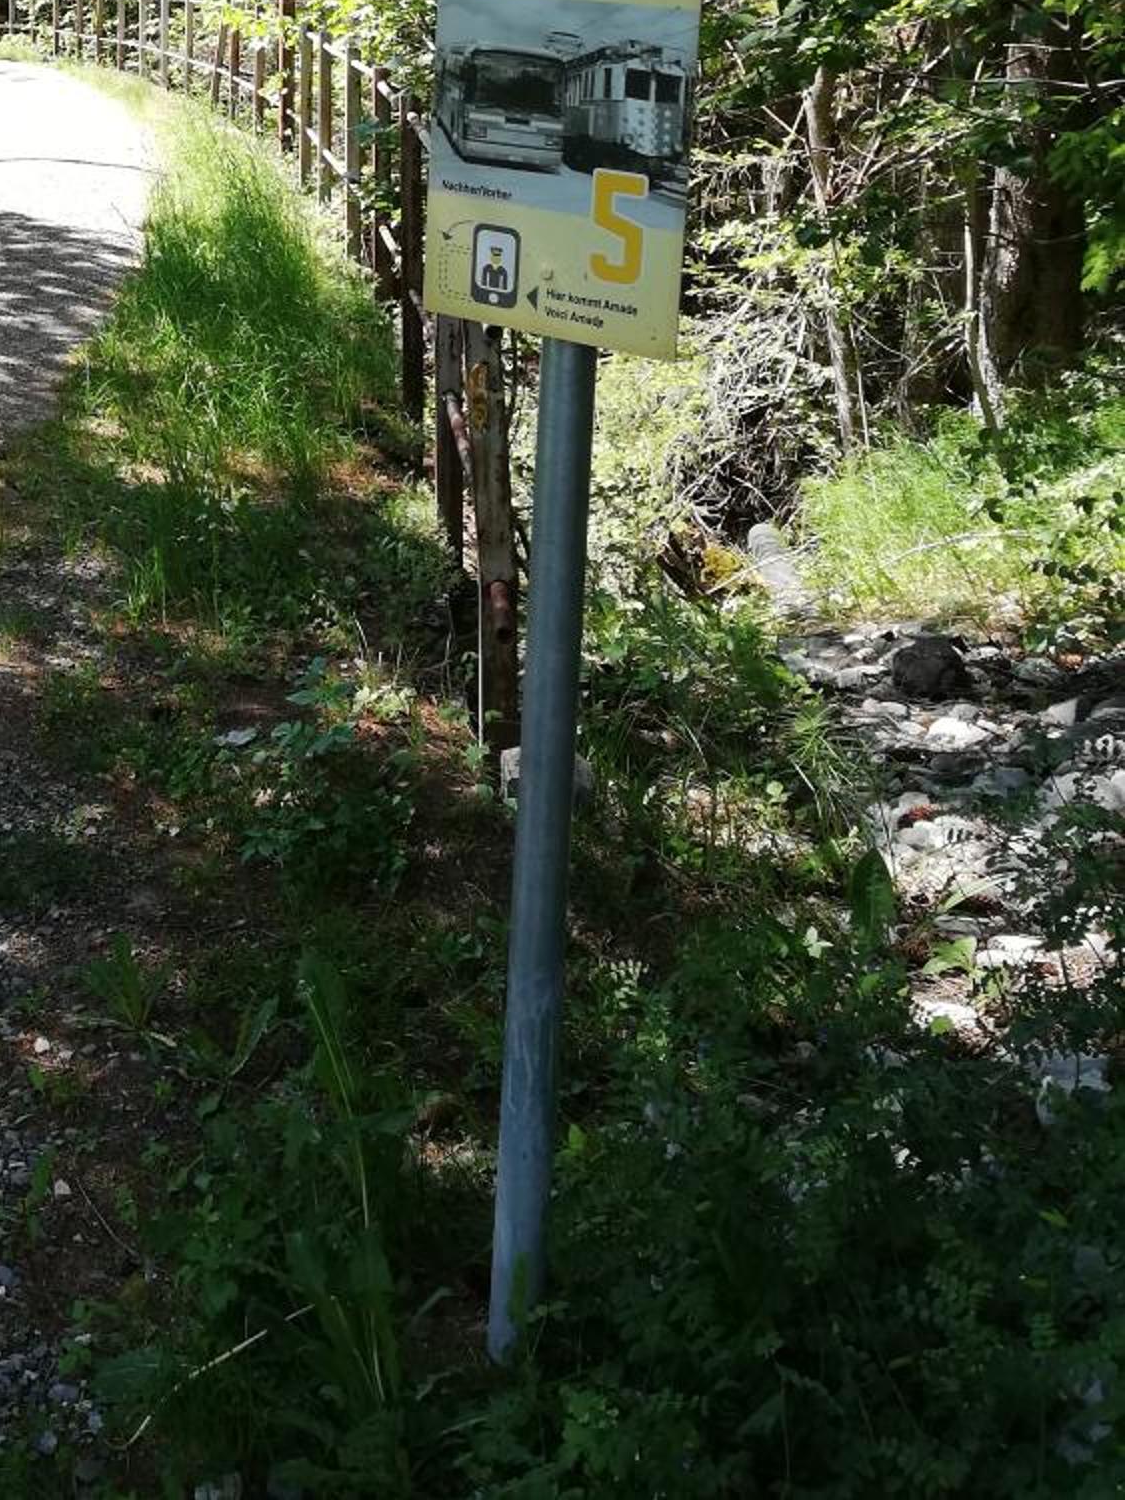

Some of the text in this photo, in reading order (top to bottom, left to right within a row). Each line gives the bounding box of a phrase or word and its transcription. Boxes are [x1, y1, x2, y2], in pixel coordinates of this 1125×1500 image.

[590, 168, 648, 284] 5
[546, 287, 566, 301] Hier
[568, 291, 602, 309] kommt
[545, 305, 568, 320] Voici
